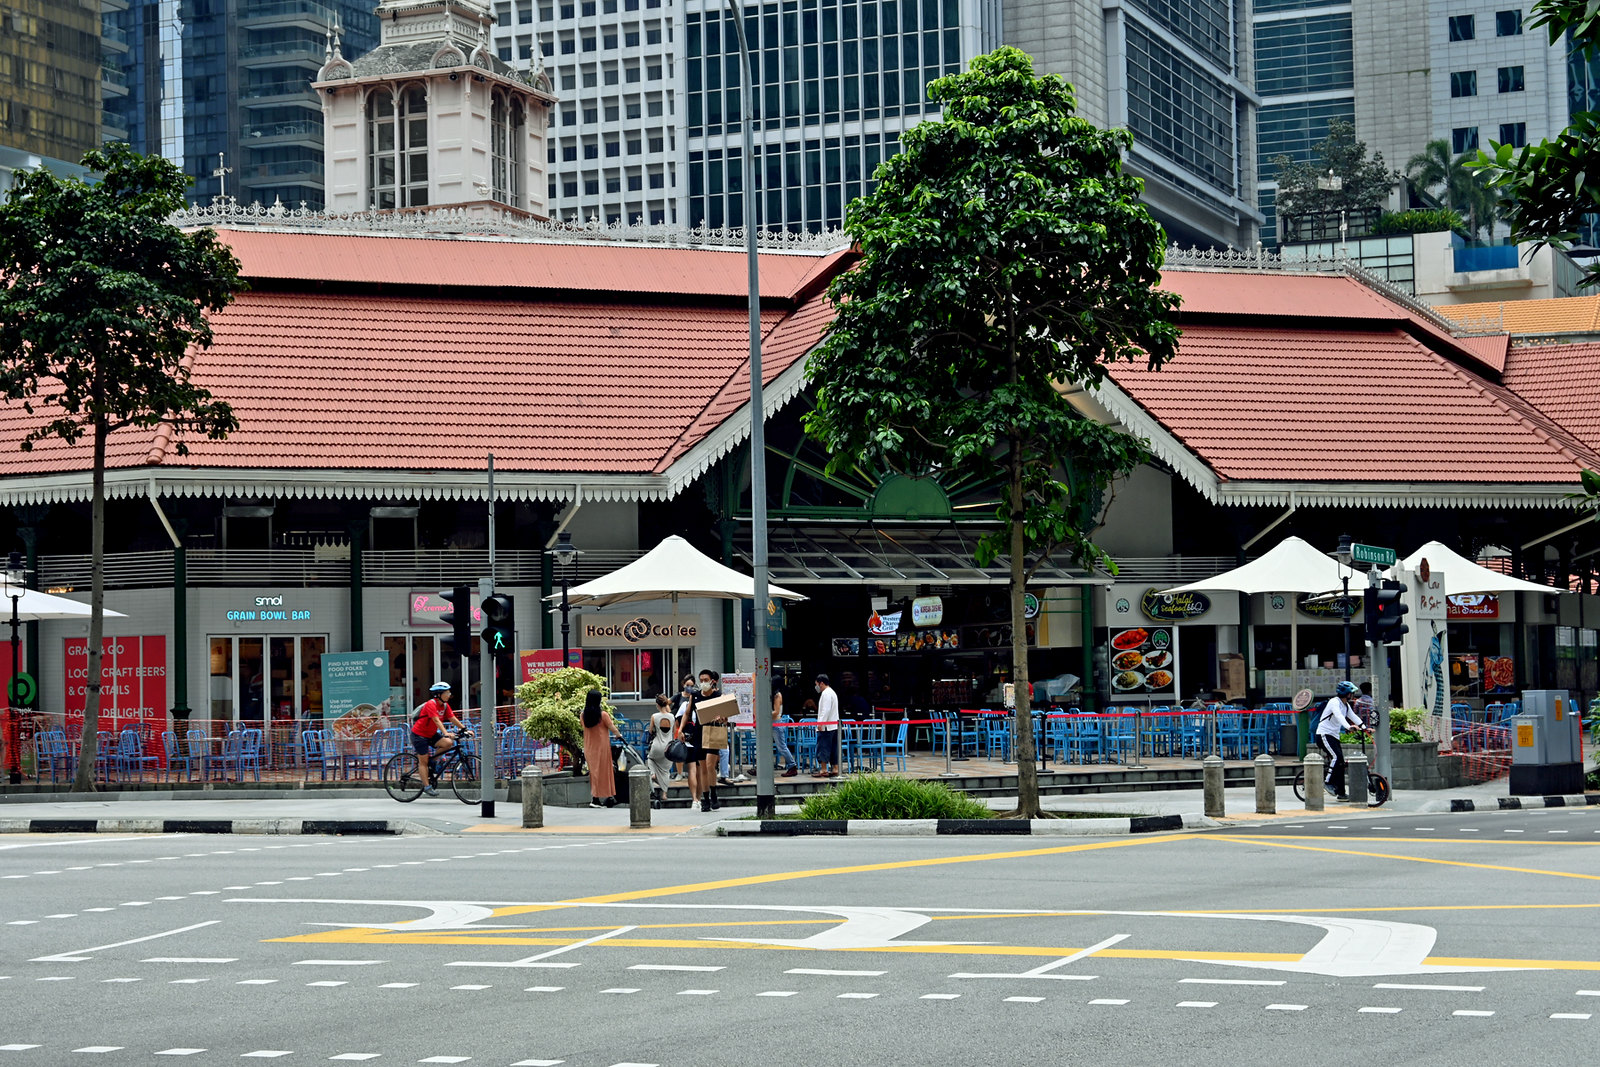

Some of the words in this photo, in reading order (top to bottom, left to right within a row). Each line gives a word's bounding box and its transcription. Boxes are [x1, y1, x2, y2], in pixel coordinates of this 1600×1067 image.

[1356, 546, 1385, 562] Robinson
[1386, 550, 1394, 564] Rd
[255, 595, 282, 606] smol
[226, 610, 256, 620] GRAIN
[260, 610, 287, 620] BOWL
[291, 610, 311, 620] BAR
[586, 624, 622, 636] Hook
[101, 667, 133, 677] CRAFT
[135, 666, 166, 677] BEERS
[68, 686, 75, 696] &
